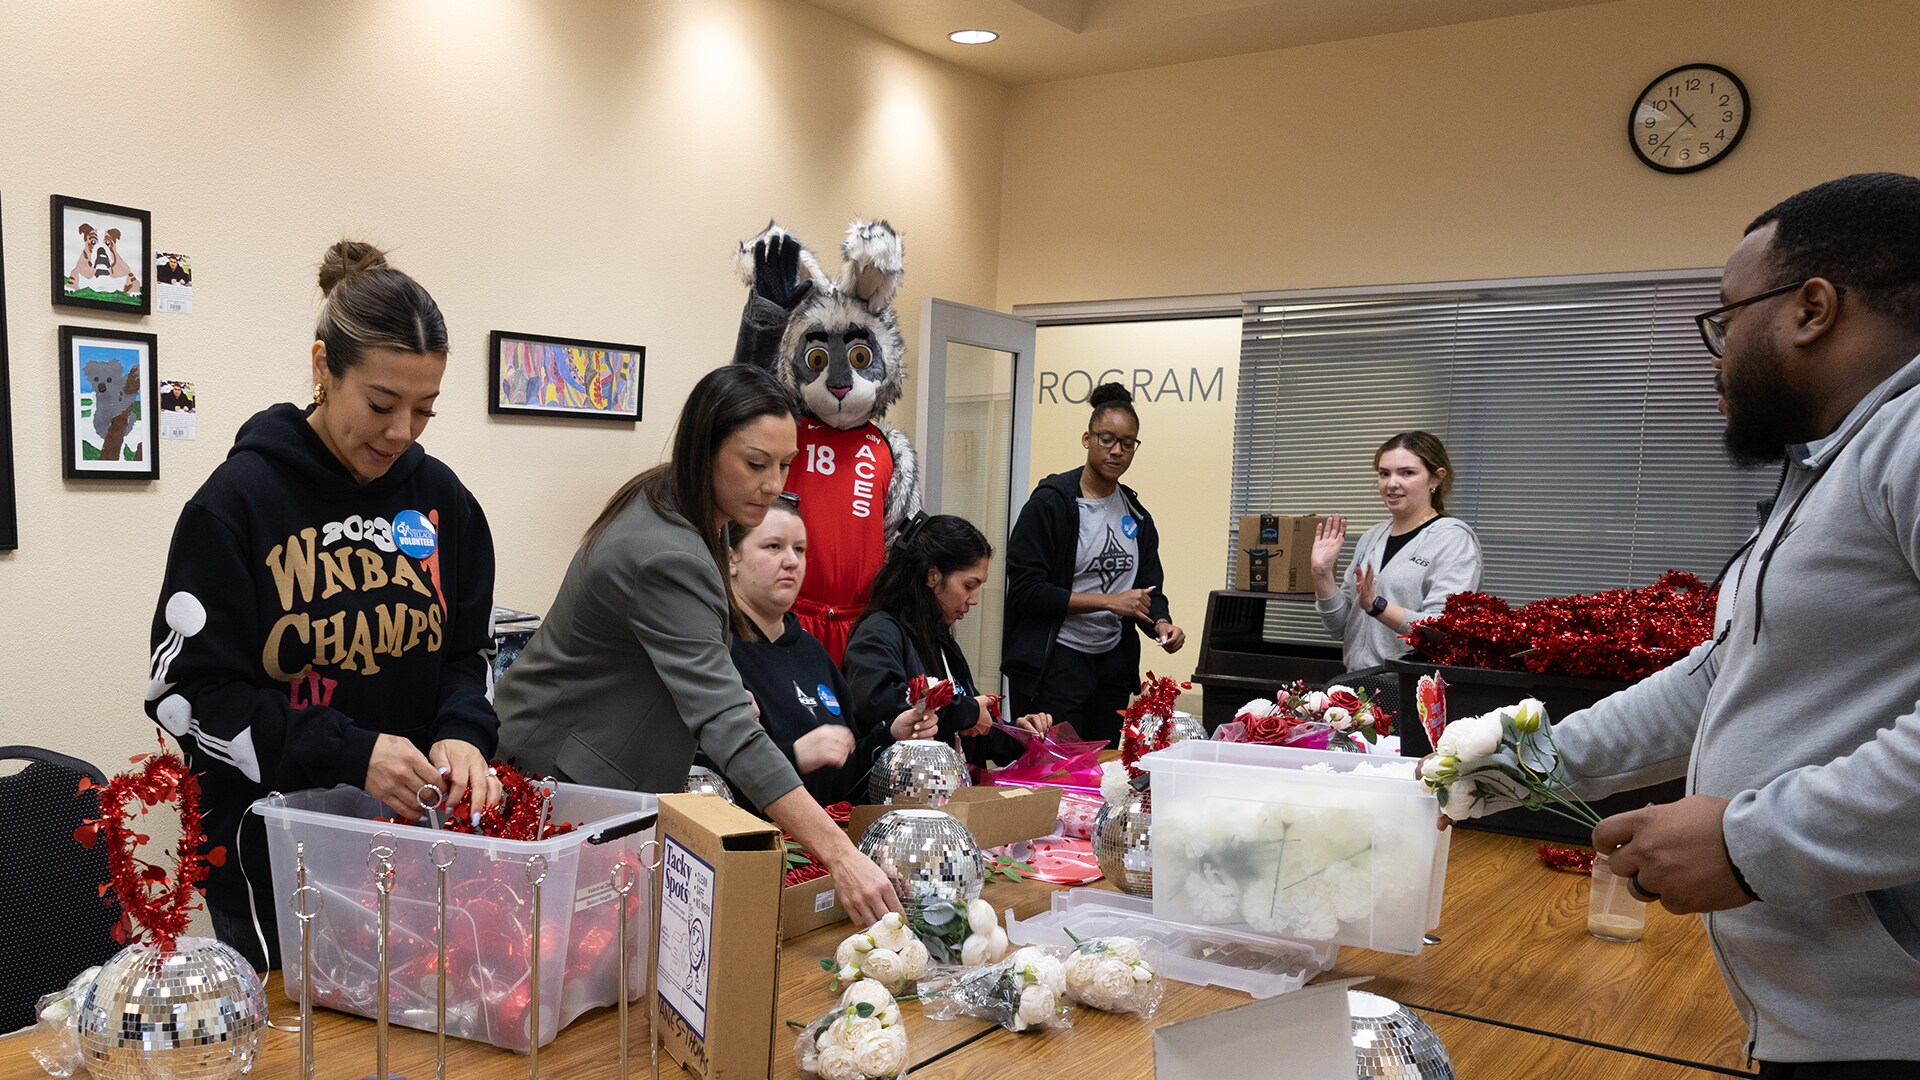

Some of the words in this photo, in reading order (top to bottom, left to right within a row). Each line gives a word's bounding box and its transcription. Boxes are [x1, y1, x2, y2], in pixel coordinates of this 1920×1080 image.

[1685, 79, 1701, 91] 12
[1709, 82, 1715, 94] 1
[1668, 86, 1680, 97] 11
[1652, 100, 1668, 112] 10
[1719, 94, 1730, 107] 2
[1645, 117, 1656, 128] 9
[1721, 111, 1733, 122] 3
[1648, 134, 1659, 146] 8
[1714, 129, 1725, 141] 4
[1661, 145, 1671, 157] 7
[1679, 149, 1690, 160] 6
[1698, 143, 1710, 154] 5
[1034, 366, 1224, 405] ROGRAM
[806, 443, 836, 476] 18
[852, 444, 877, 518] ACES
[322, 514, 398, 552] 2023
[399, 536, 435, 547] VOLUNTEER
[1089, 556, 1133, 571] ACES
[1409, 556, 1430, 567] ACES
[265, 527, 432, 612] WNBA
[262, 603, 442, 682] CHAMPS
[665, 843, 692, 886] Tacky
[664, 868, 689, 905] Spots
